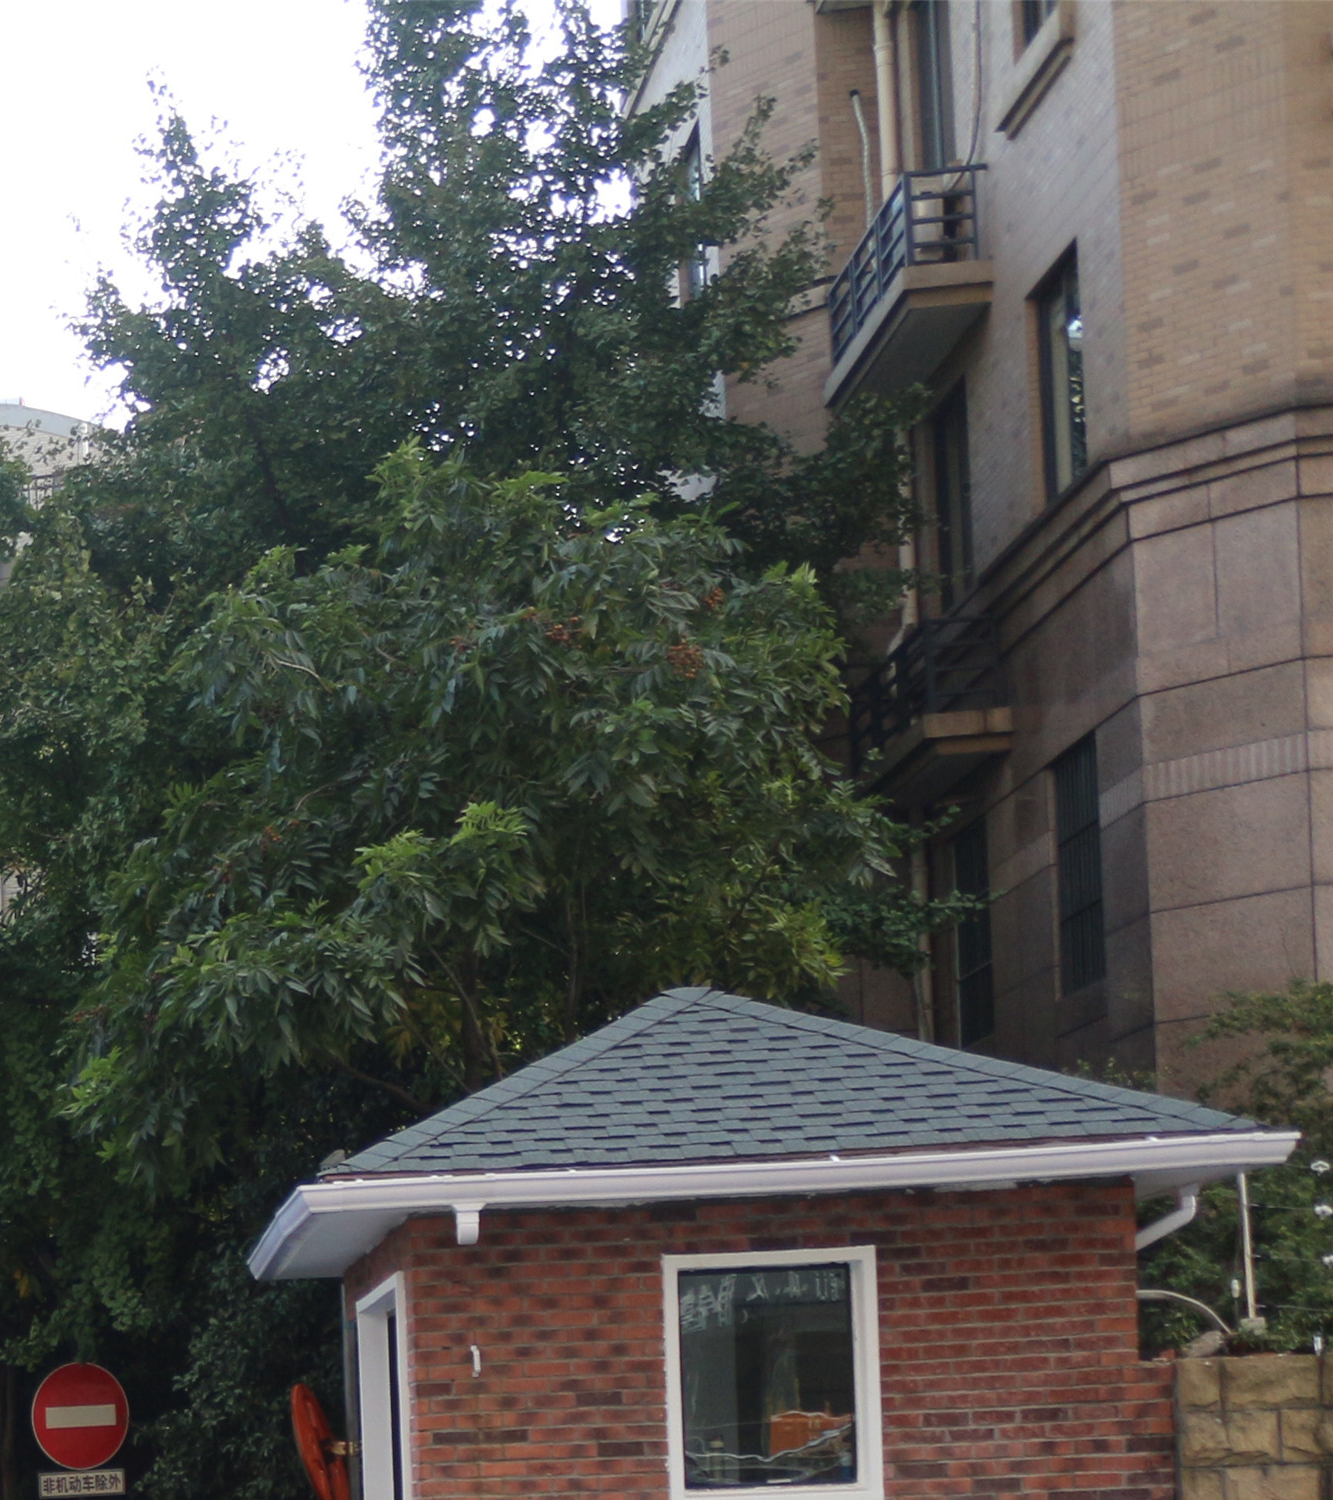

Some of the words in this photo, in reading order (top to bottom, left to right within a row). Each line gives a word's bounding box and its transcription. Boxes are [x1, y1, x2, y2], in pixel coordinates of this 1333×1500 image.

[43, 1474, 121, 1494] 非机动车除外
